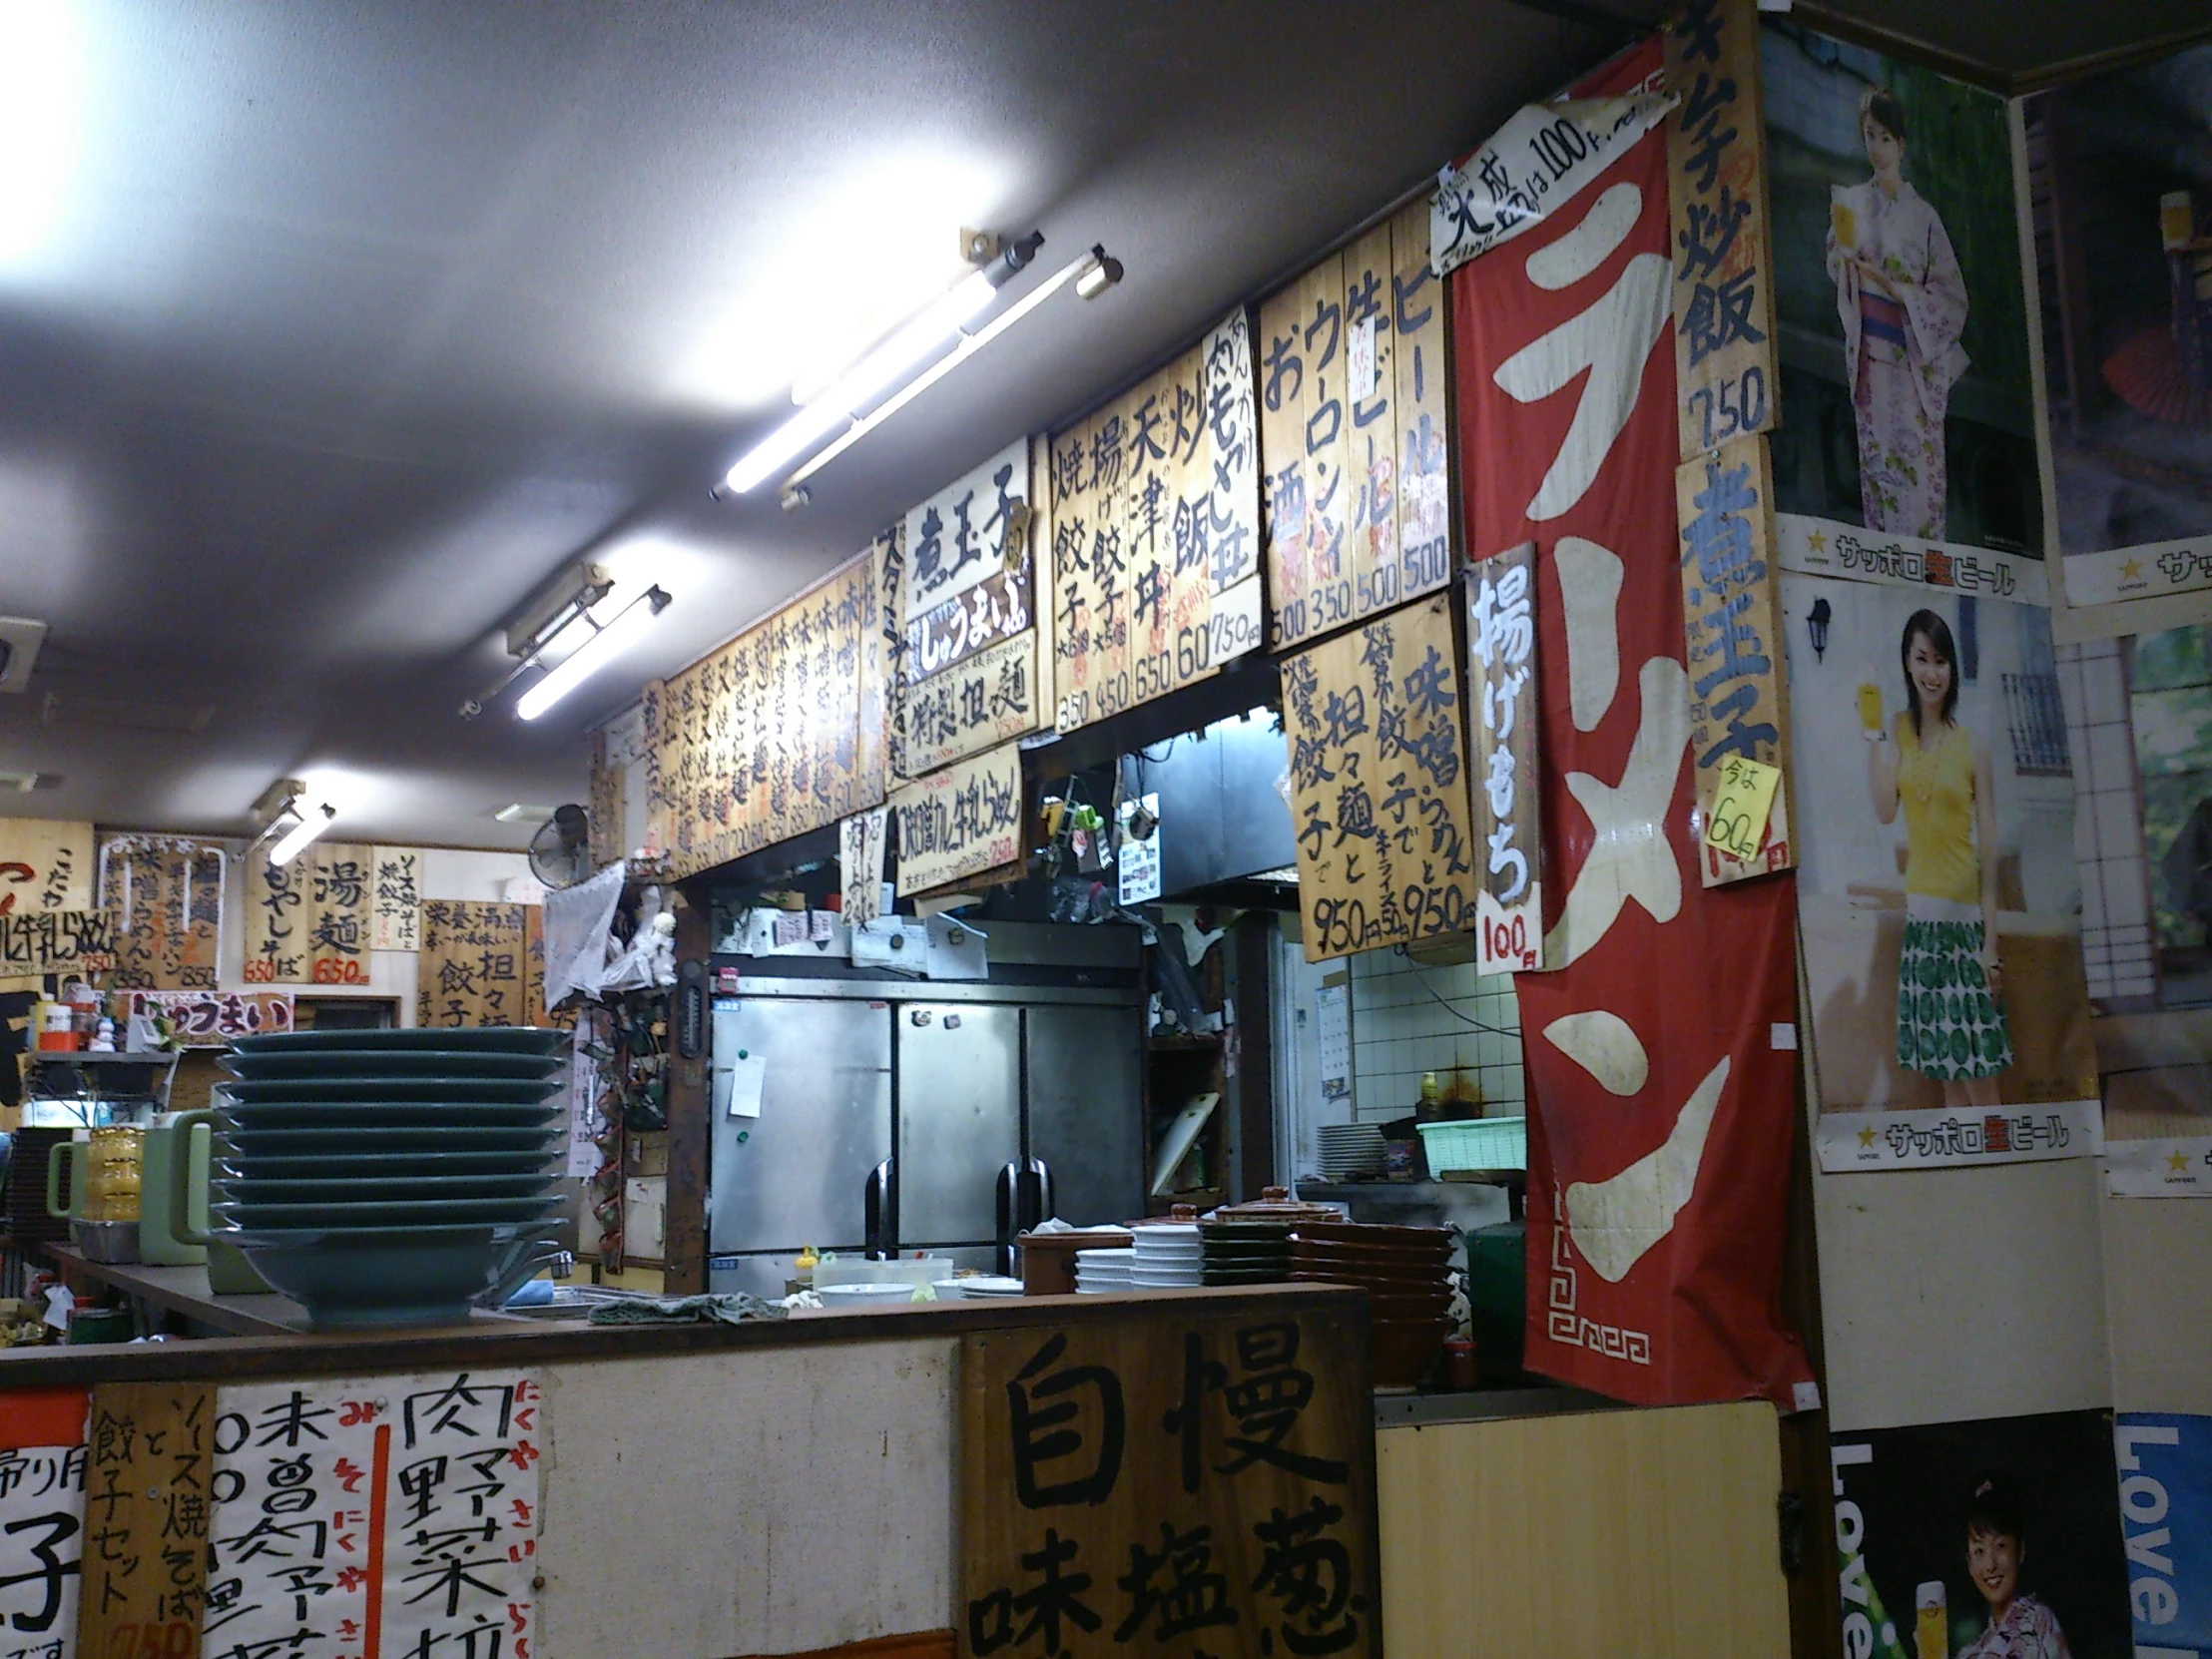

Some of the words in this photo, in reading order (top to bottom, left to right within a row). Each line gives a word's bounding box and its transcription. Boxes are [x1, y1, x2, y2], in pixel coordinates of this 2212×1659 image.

[1264, 324, 1304, 544] お酒
[1305, 299, 1346, 576] ウーロンハイ
[1688, 365, 1766, 448] 750
[1129, 395, 1166, 631] 天津丼
[1170, 369, 1209, 578] 炒飯
[1053, 438, 1089, 633] 焼餃子
[1089, 415, 1126, 627] 揚げ餃子
[1403, 536, 1446, 592] 500
[1835, 534, 2015, 596] サッポロ生ビール
[1271, 598, 1306, 646] 500
[1310, 580, 1351, 631] 350
[1357, 563, 1397, 612] 500
[1058, 690, 1090, 731] 350
[1096, 670, 1129, 718] 450
[1135, 649, 1171, 701] 650
[1470, 561, 1535, 904] 揚げもち
[1491, 181, 1731, 1286] ラーメン
[1725, 761, 1759, 793] 今は
[40, 847, 73, 908] こだわ
[311, 861, 363, 955] 湯麺
[244, 958, 276, 983] 650
[1314, 897, 1382, 953] 950円
[437, 958, 479, 1027] 餃子
[1886, 1115, 2069, 1158] サッポロ生ビール
[1006, 1320, 1352, 1510] 自慢
[93, 1410, 140, 1615] 餃子セット
[332, 1400, 378, 1659] みそにくやさ
[1831, 1442, 1874, 1659] Love
[2115, 1424, 2180, 1626] Love
[0, 1510, 82, 1633] 子
[968, 1527, 1102, 1659] 味
